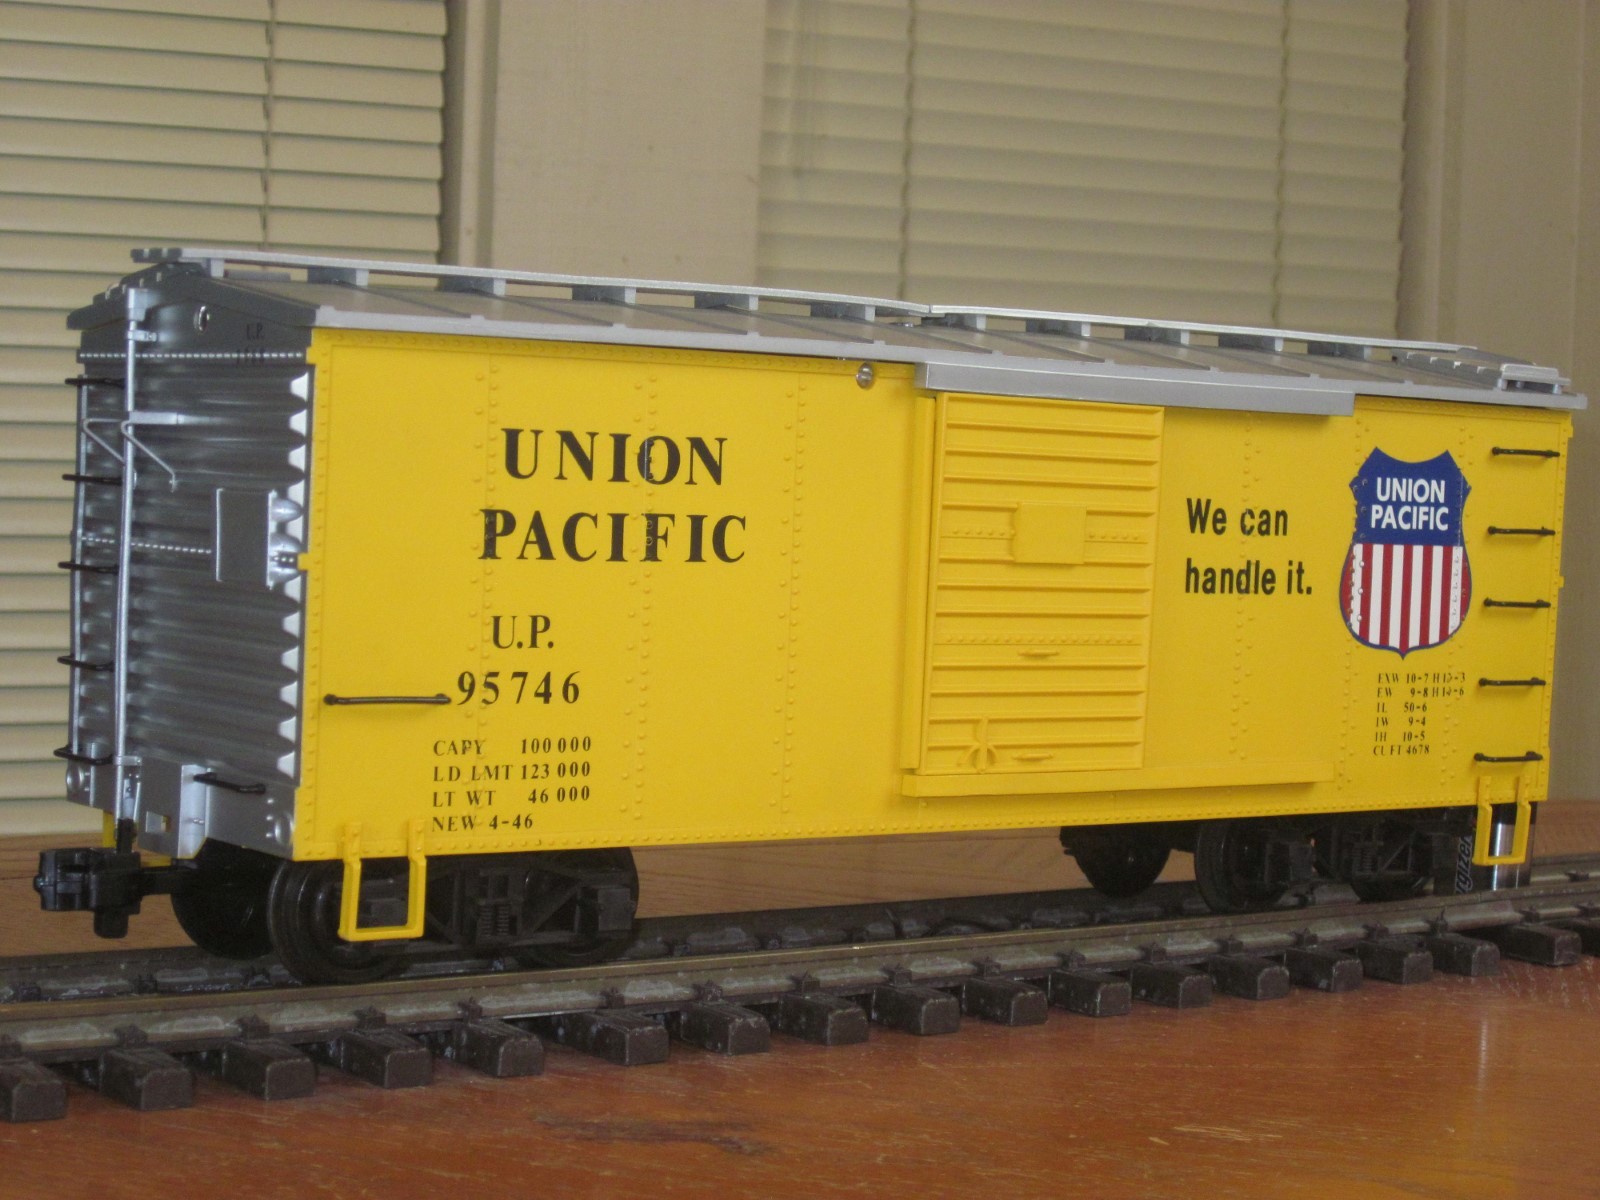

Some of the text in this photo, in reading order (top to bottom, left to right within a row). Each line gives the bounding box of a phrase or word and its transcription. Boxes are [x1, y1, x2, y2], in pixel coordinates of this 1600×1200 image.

[501, 428, 728, 485] UNION
[1376, 477, 1446, 503] UNION
[1186, 498, 1288, 536] We can
[1371, 504, 1449, 531] PACIFIC
[478, 508, 746, 563] PACIFIC
[1185, 558, 1313, 595] handle it.
[491, 615, 554, 649] U.P.
[457, 671, 580, 705] 95746
[1404, 702, 1428, 713] 50-6
[1408, 716, 1426, 726] 9-4
[433, 739, 487, 756] CAPY
[1403, 731, 1426, 742] 10-5
[433, 766, 461, 782] LD
[471, 765, 514, 781] LMT
[432, 791, 456, 807] LT
[466, 790, 497, 807] WT
[432, 813, 534, 832] NEW 4-46
[1454, 835, 1473, 894] rgizer
